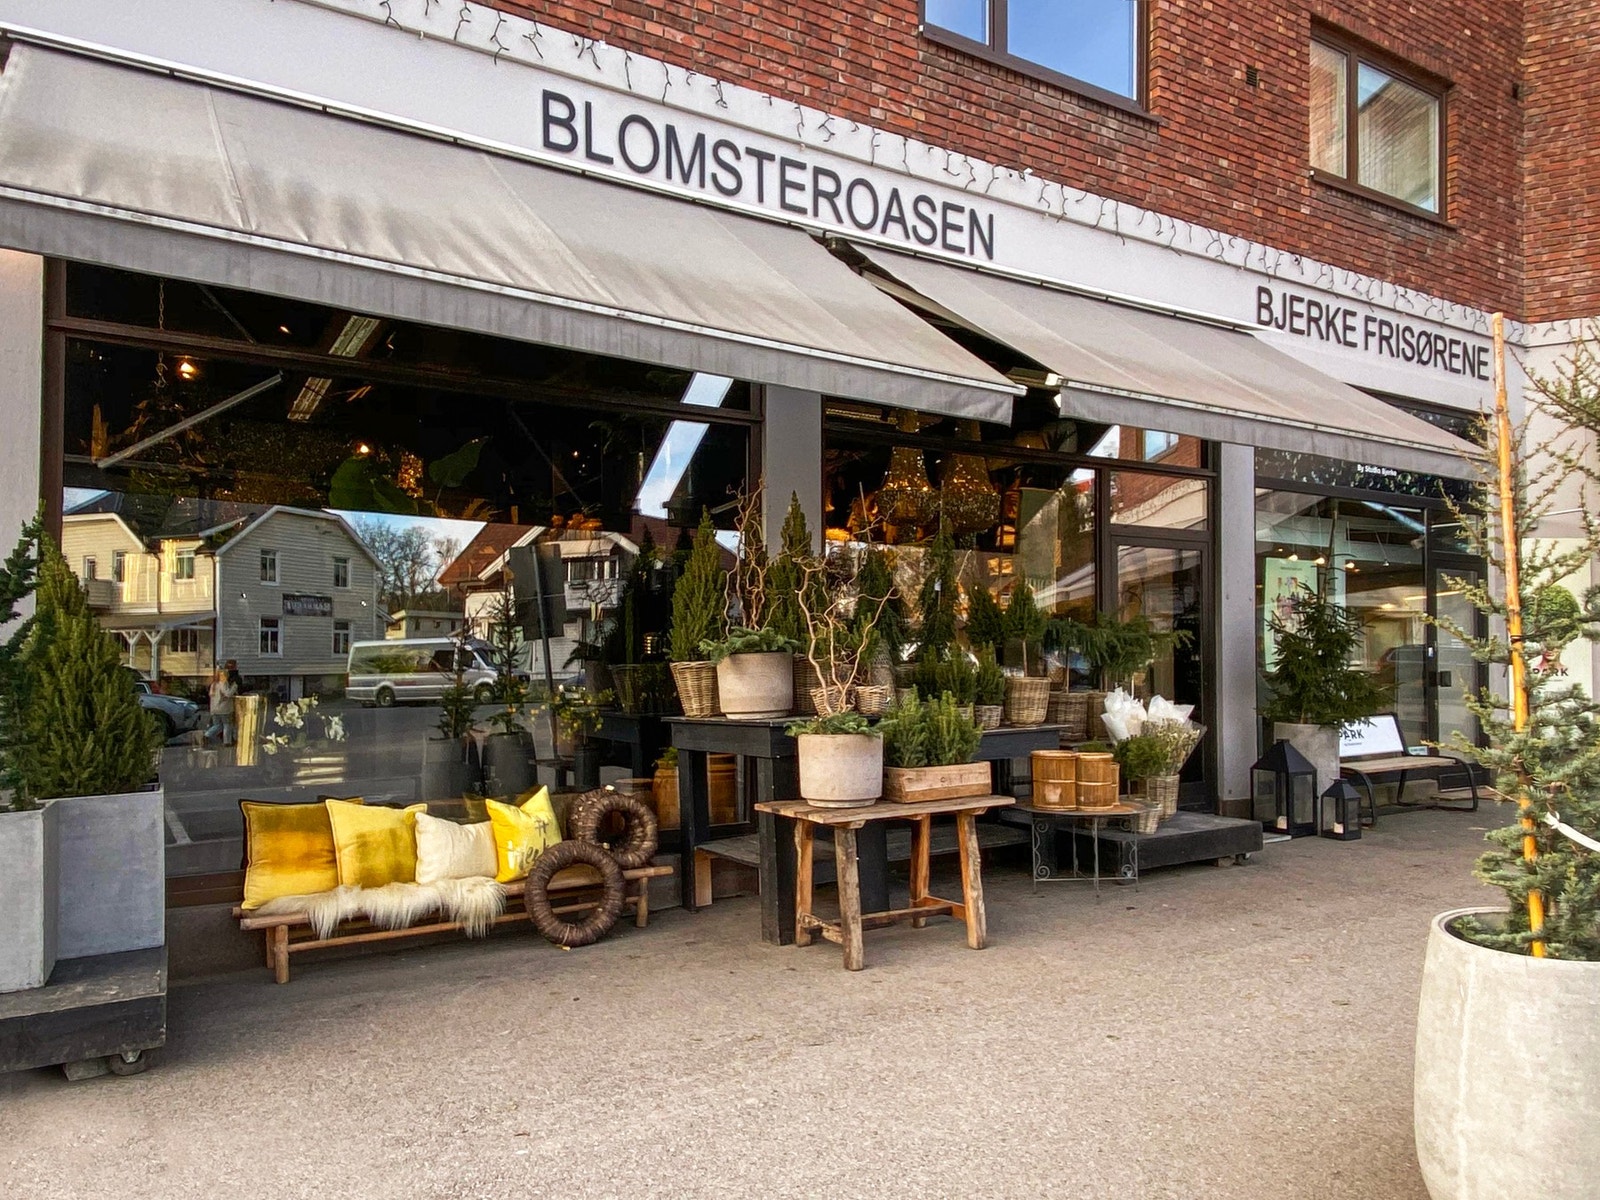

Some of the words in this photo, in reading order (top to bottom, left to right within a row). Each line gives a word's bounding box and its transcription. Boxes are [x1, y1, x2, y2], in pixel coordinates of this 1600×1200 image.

[541, 89, 994, 260] BLOMSTEROASEN
[1256, 285, 1358, 348] BJERKE
[1363, 314, 1490, 381] FRISØRENE
